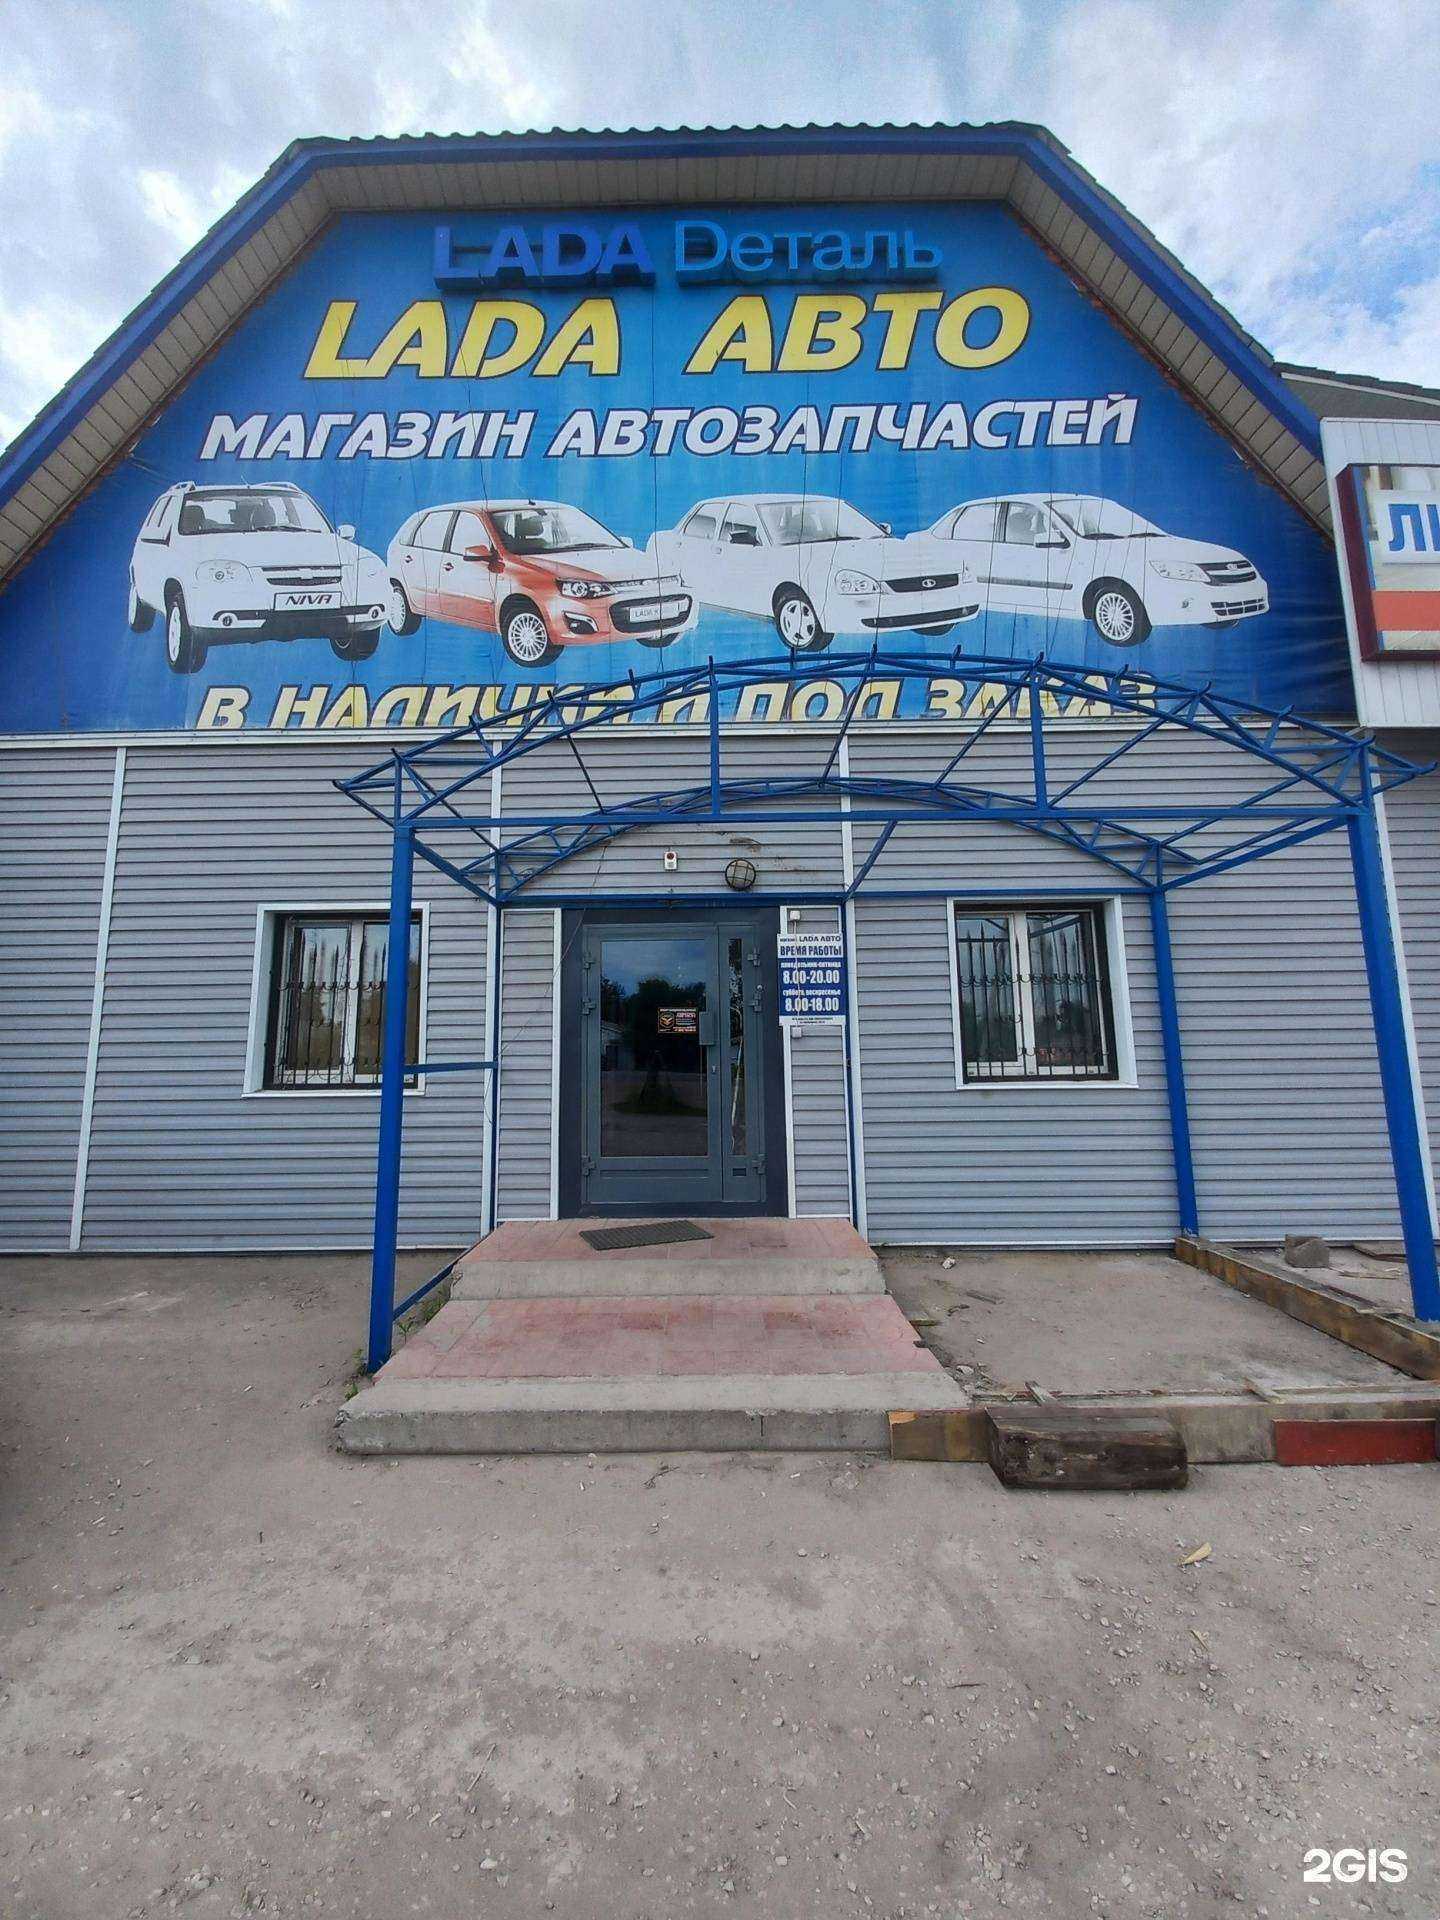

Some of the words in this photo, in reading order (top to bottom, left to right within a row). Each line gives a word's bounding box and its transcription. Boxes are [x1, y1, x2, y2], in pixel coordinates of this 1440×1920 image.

[434, 224, 655, 282] LADA
[303, 297, 620, 379] LADA
[683, 286, 1030, 375] АВТО
[199, 409, 538, 461] МАГАЗИН
[544, 393, 1141, 458] АВТОЗАПЧАСТЕЙ
[285, 595, 332, 605] NIVA
[196, 684, 252, 728] В
[734, 677, 903, 722] ПОД
[781, 946, 807, 956] ВРЕМЯ
[809, 945, 841, 956] РАБОТЫ
[783, 970, 840, 984] 8.00-20.00
[785, 997, 839, 1011] 8.00-18.00
